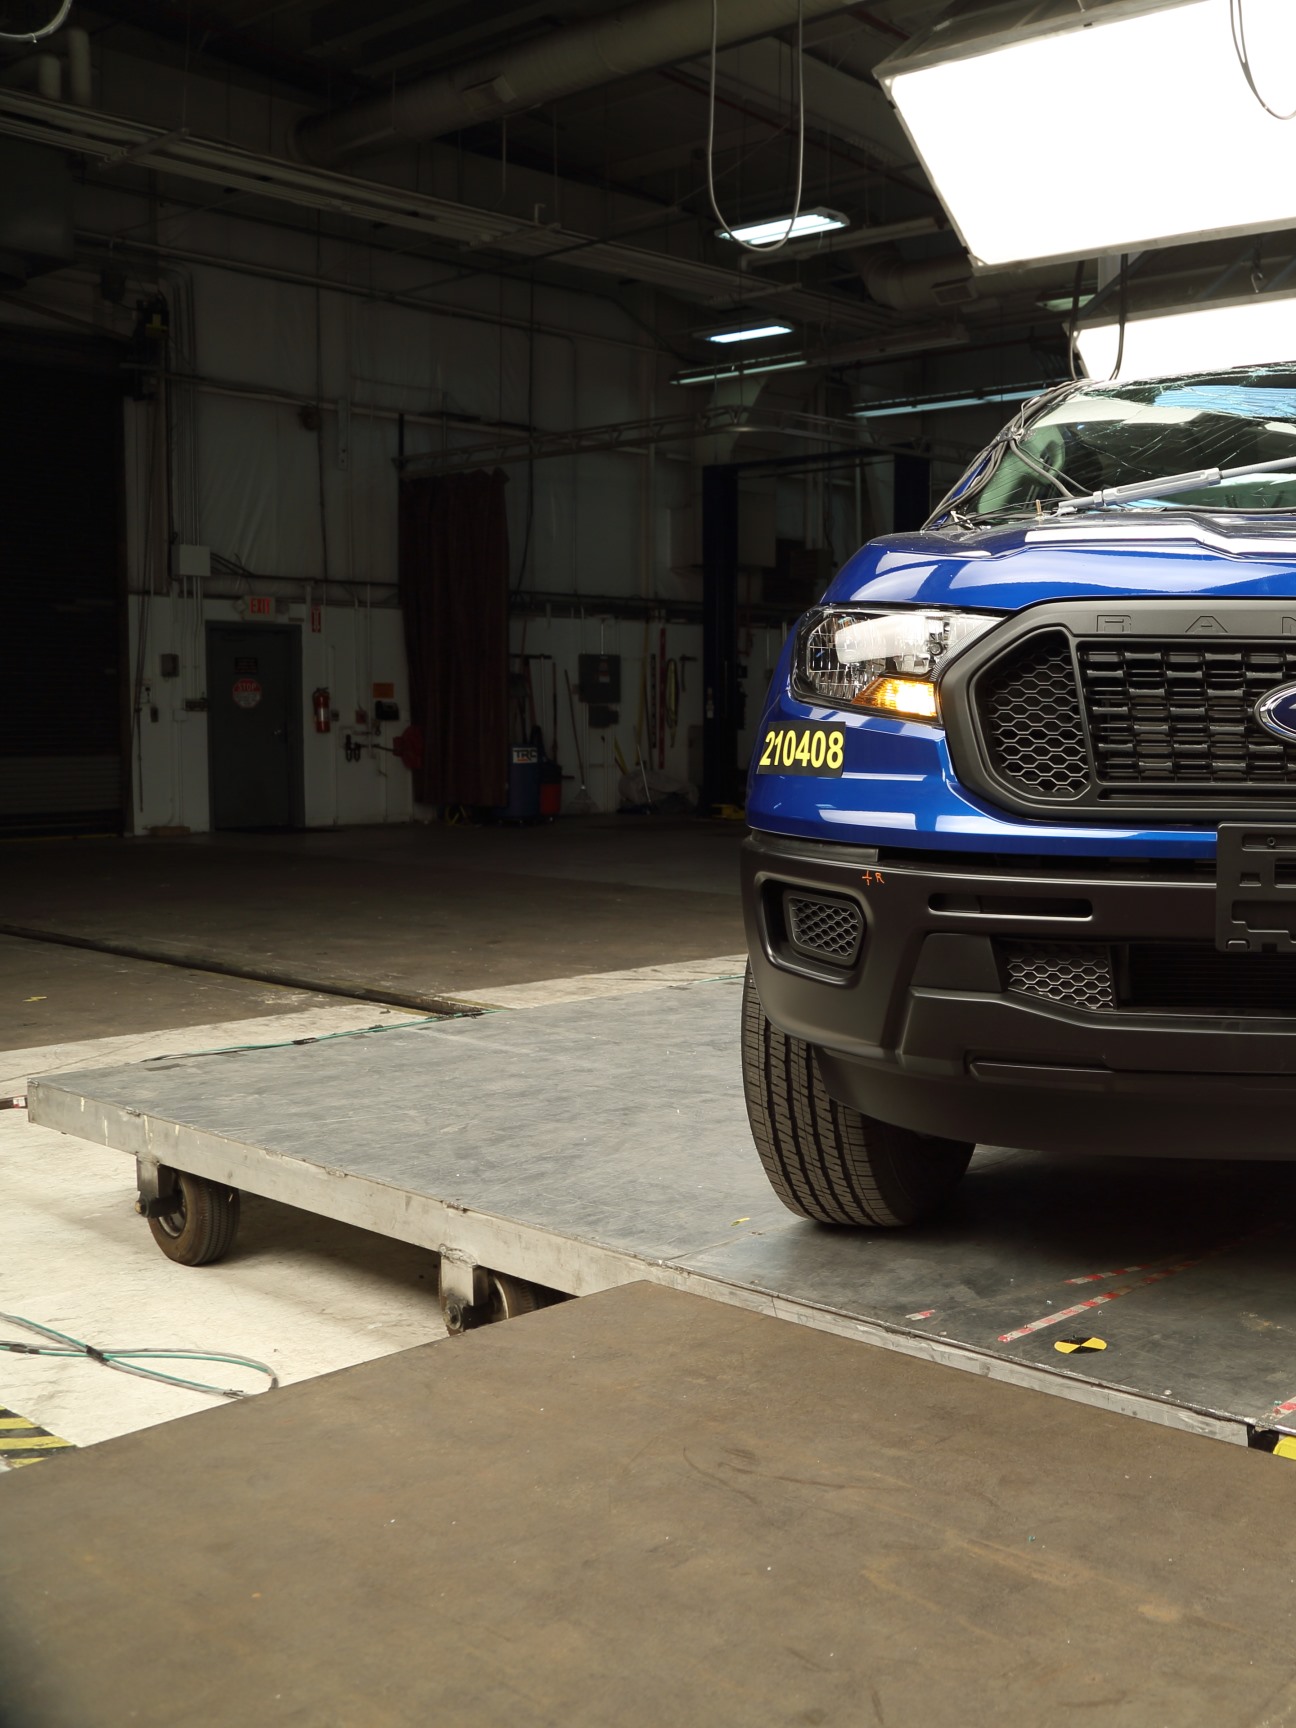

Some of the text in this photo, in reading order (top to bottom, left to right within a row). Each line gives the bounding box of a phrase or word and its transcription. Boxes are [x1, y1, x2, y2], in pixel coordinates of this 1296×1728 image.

[250, 597, 272, 615] EXIT
[238, 683, 257, 691] STOP
[759, 729, 844, 769] 210408
